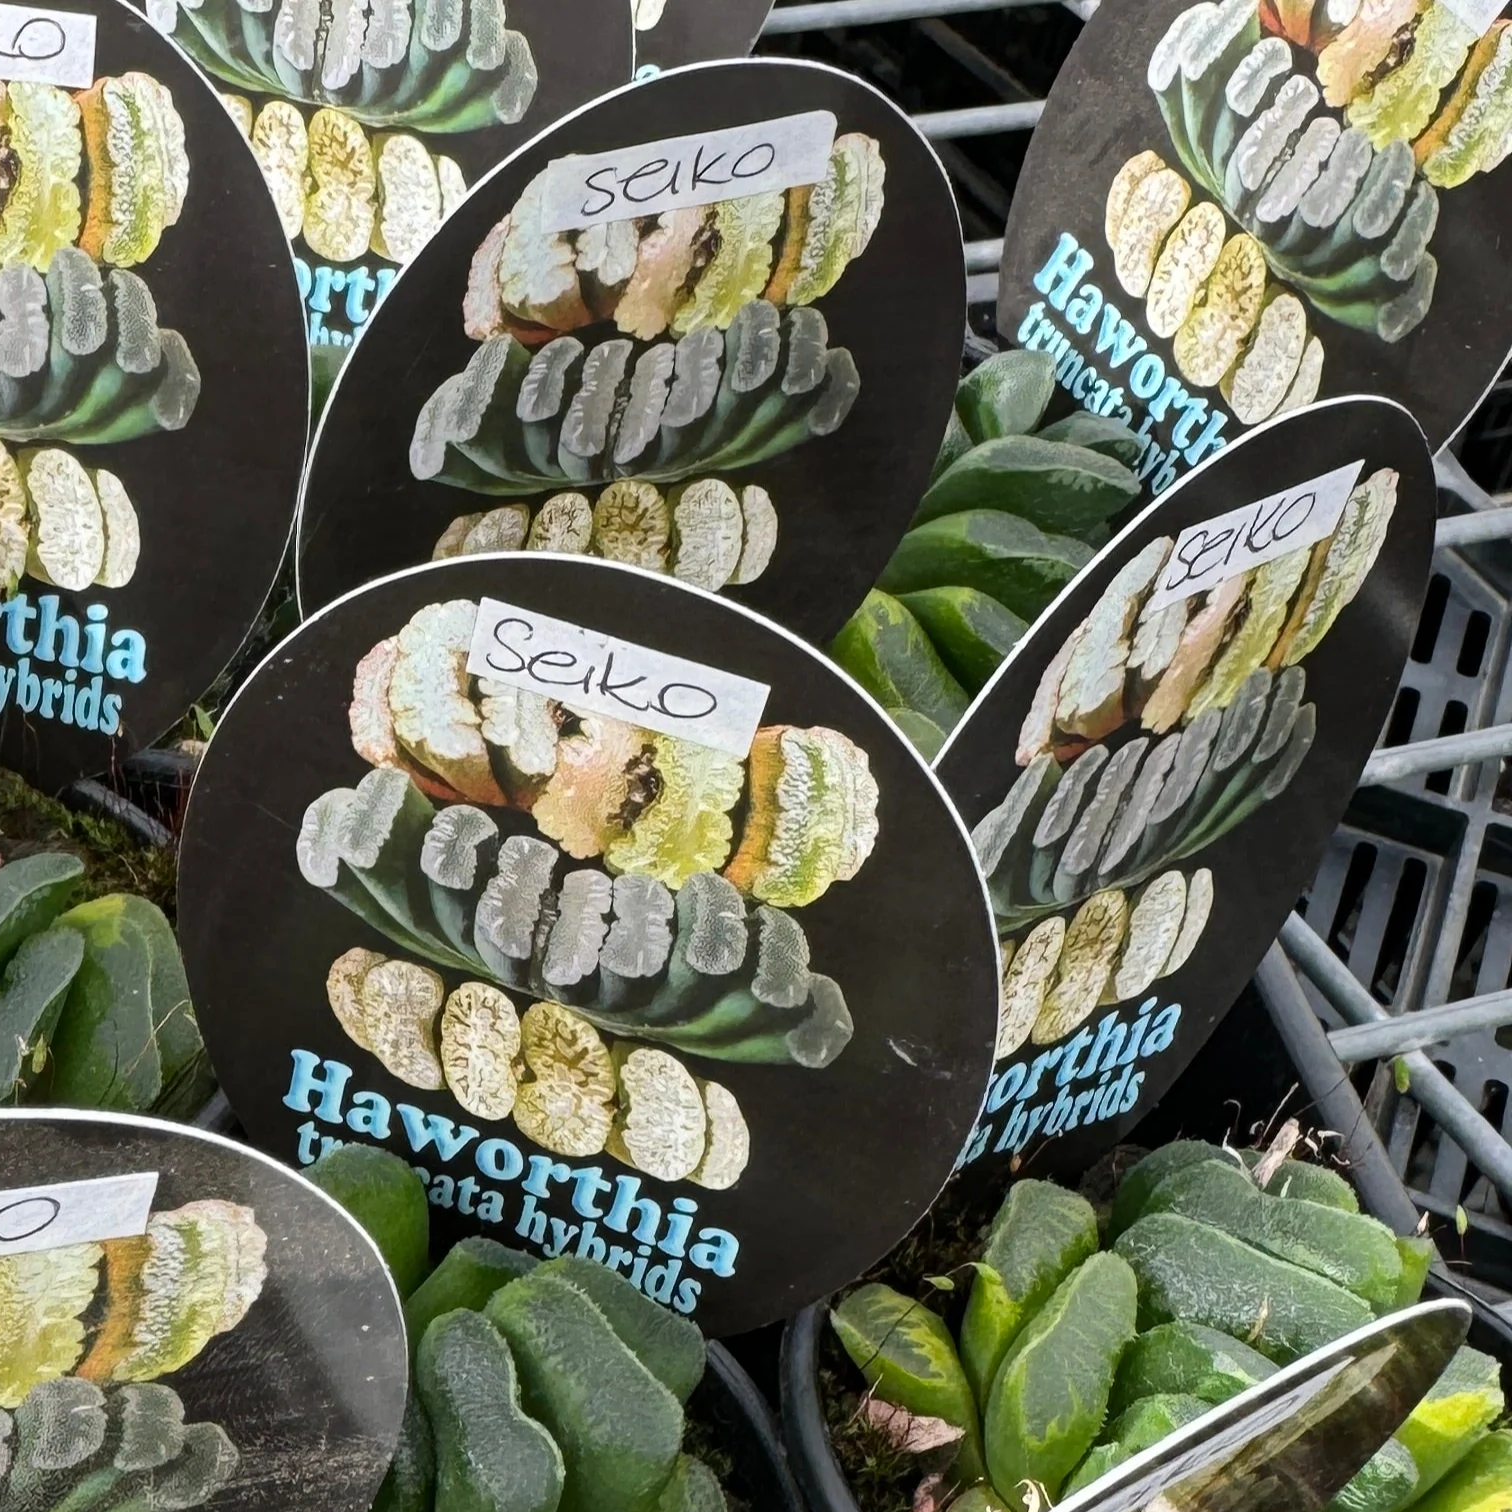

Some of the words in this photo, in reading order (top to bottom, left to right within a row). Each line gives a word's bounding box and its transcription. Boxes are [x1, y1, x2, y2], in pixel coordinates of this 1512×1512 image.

[1033, 231, 1229, 467] Haworth
[986, 995, 1182, 1114] orthia
[993, 1062, 1146, 1156] hybrids
[282, 1048, 741, 1279] Haworthia
[515, 1194, 703, 1315] hybrids
